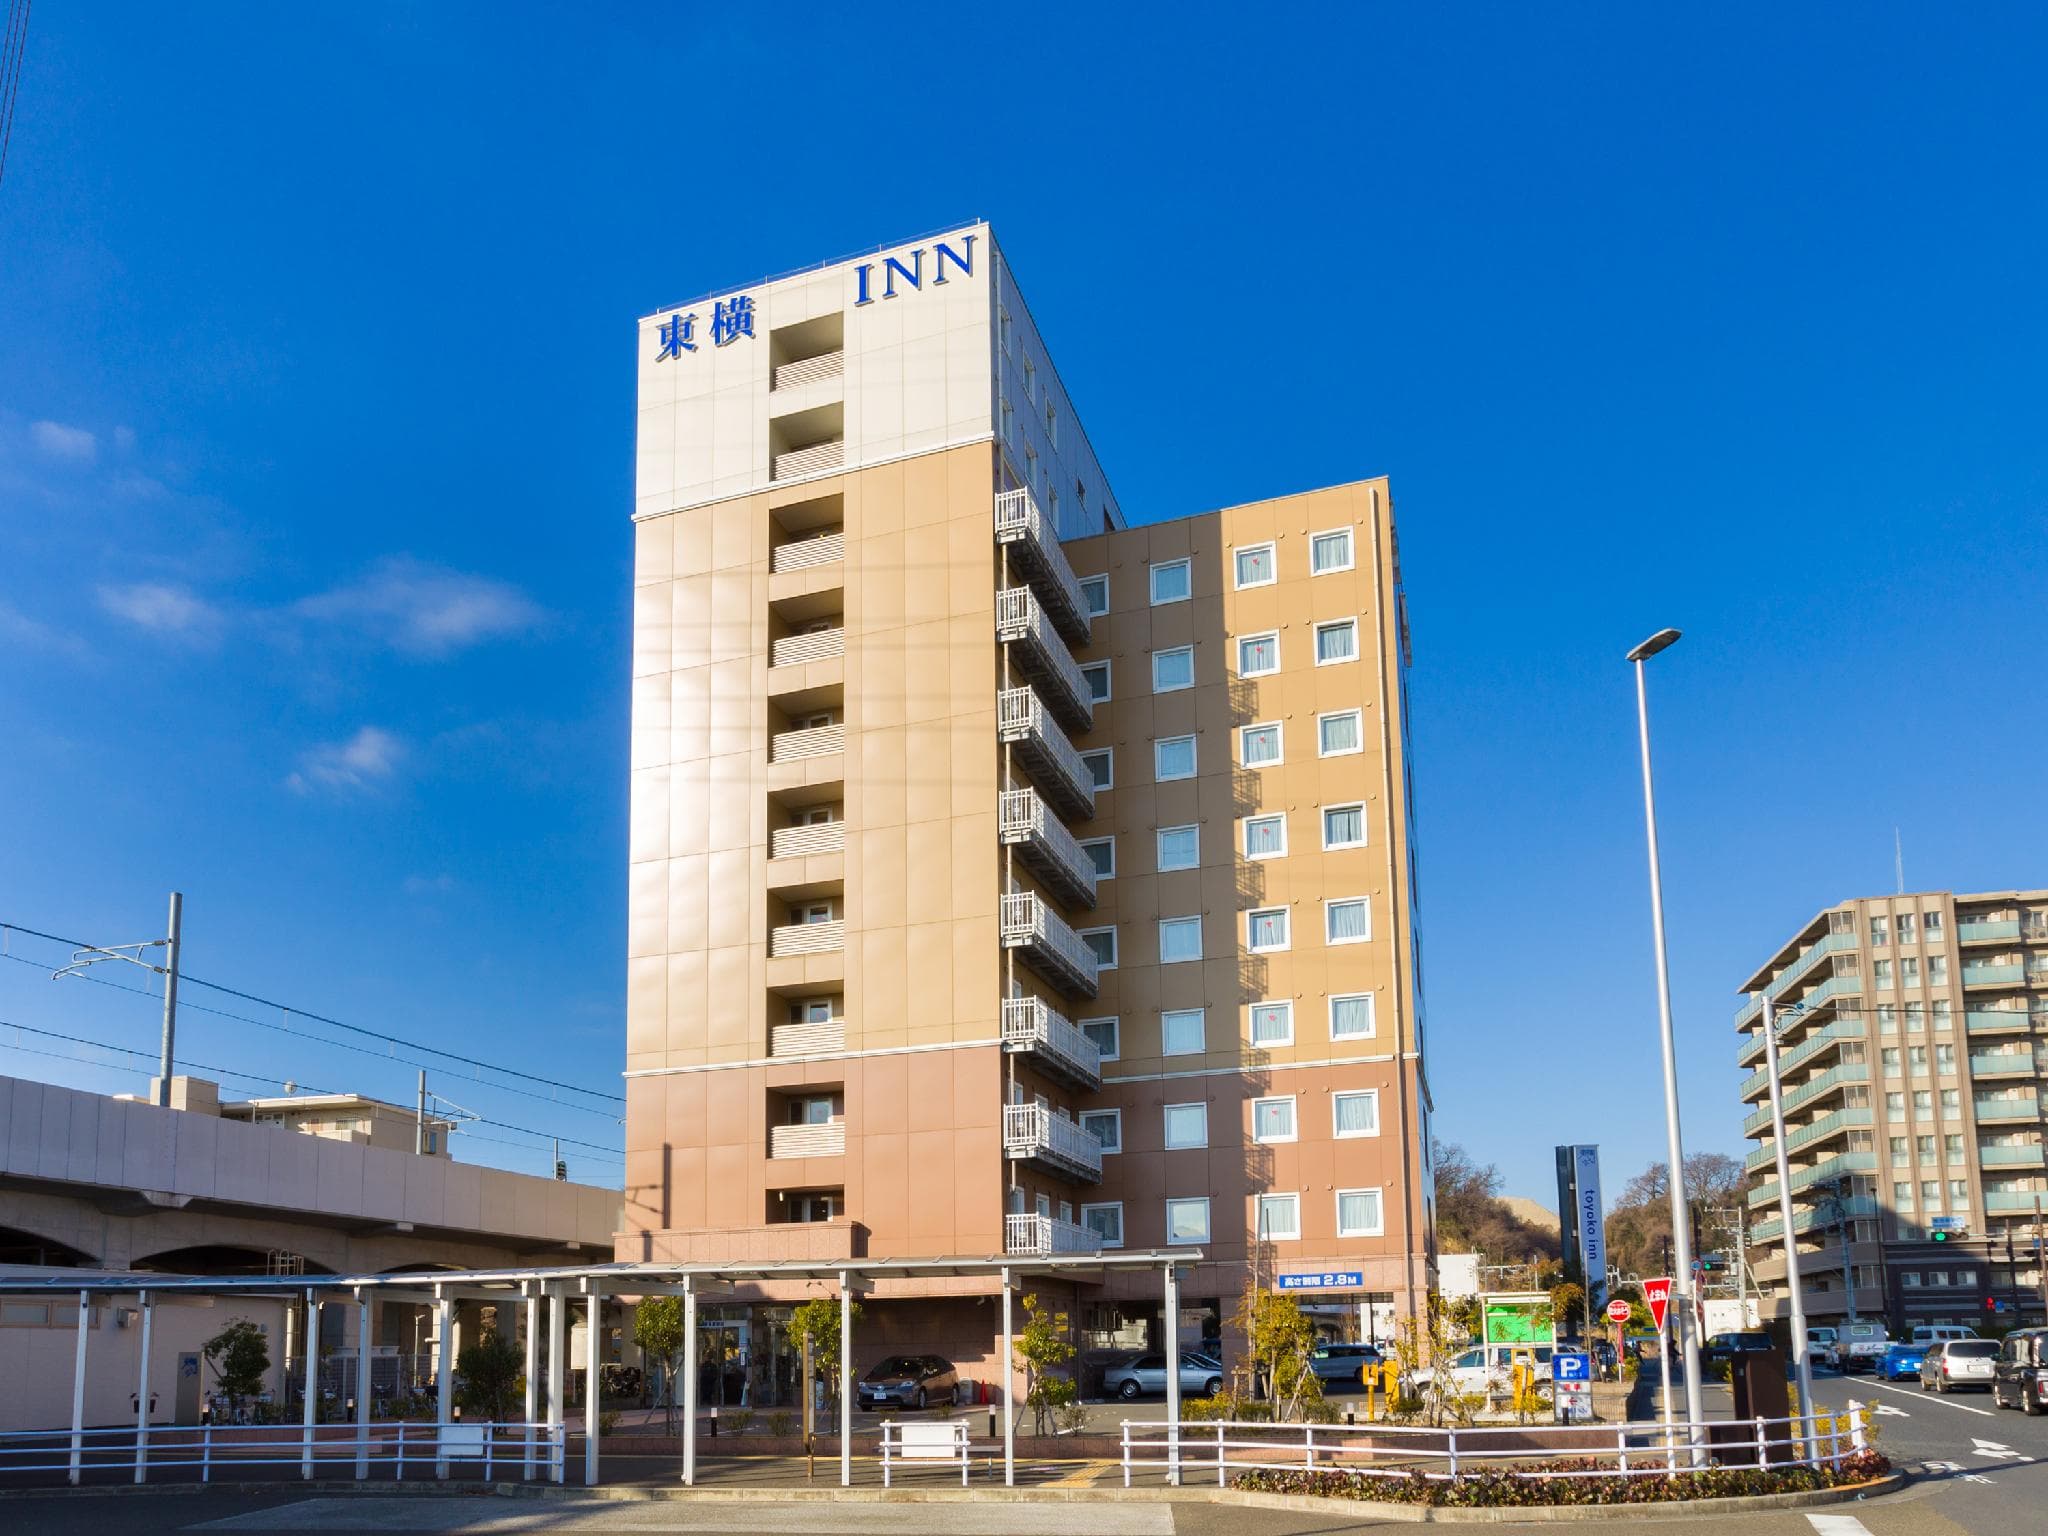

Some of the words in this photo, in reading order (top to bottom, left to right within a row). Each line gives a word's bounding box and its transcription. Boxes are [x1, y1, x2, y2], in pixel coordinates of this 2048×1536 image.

[655, 296, 757, 362] 東横
[855, 234, 978, 307] INN
[1584, 1189, 1598, 1235] toyoko
[1588, 1239, 1600, 1260] inn
[1649, 1288, 1667, 1302] 止まれ
[1560, 1357, 1582, 1378] P
